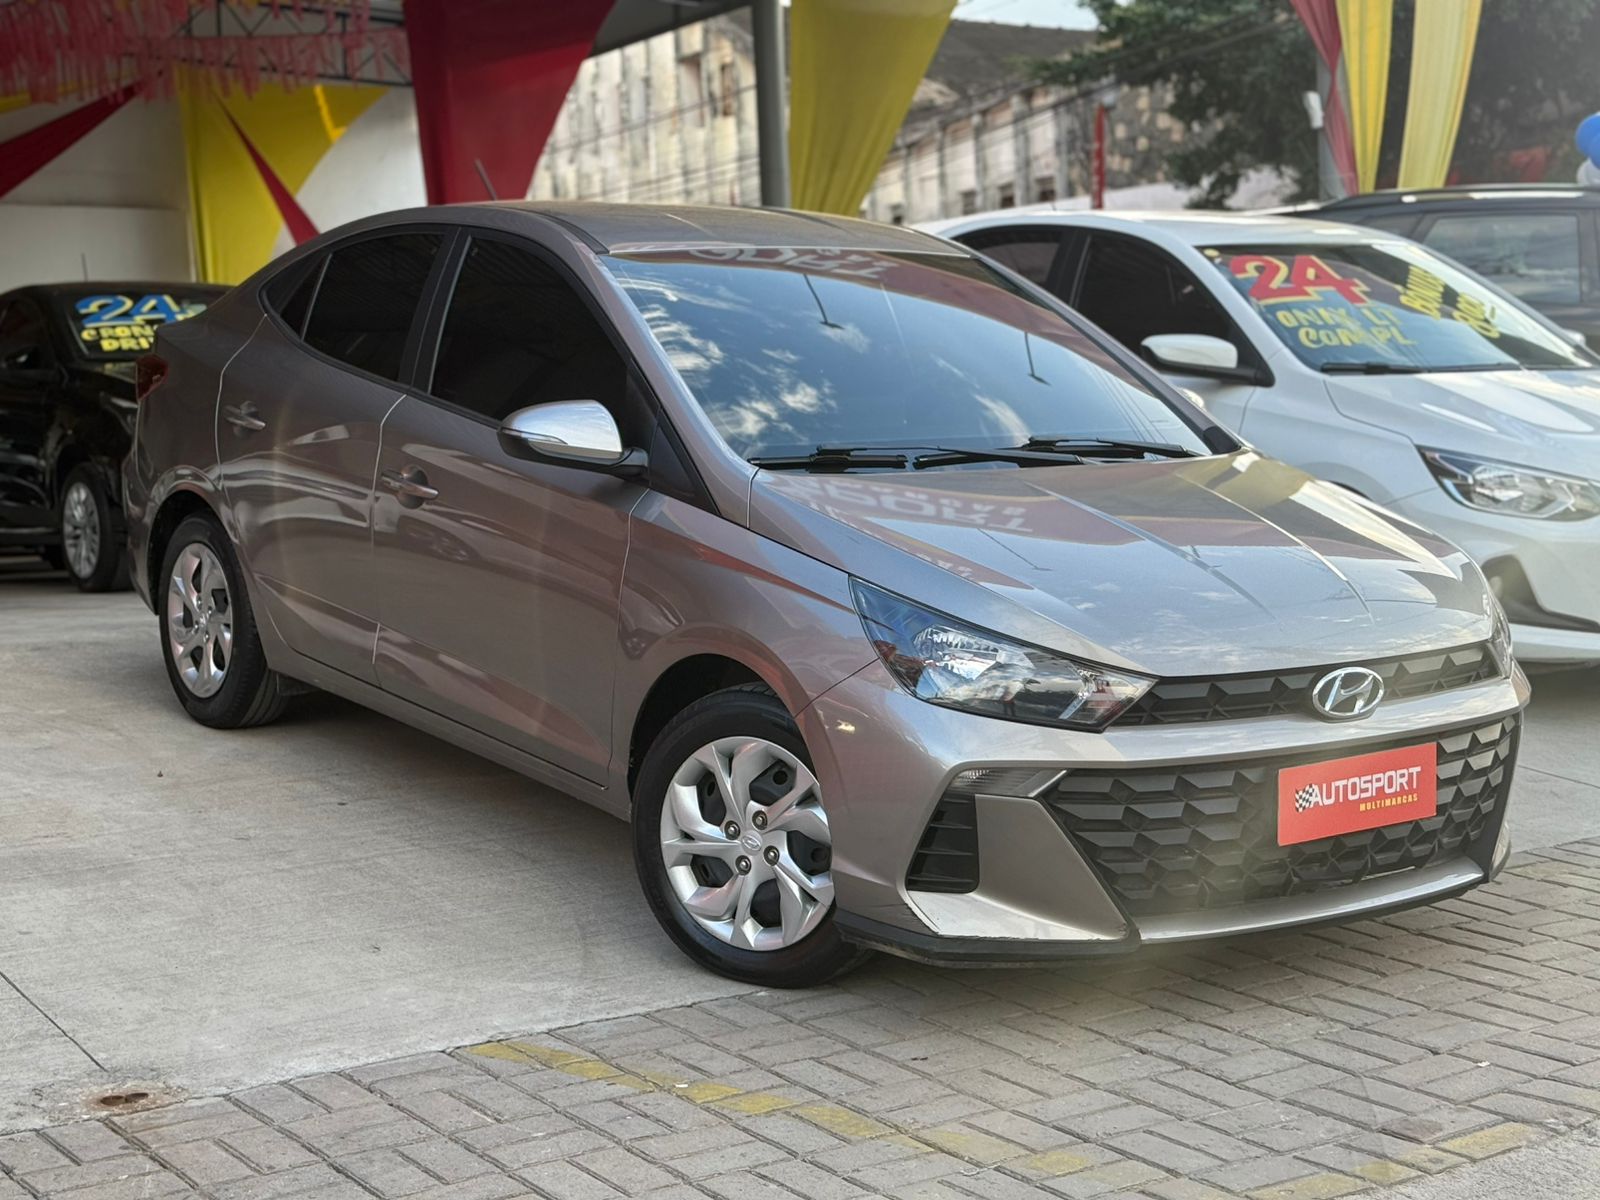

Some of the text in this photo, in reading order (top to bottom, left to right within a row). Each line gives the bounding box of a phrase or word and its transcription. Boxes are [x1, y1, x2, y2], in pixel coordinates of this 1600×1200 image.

[1228, 254, 1371, 305] 24
[75, 294, 193, 328] 24
[80, 325, 158, 341] CRON
[100, 337, 155, 352] DRI
[1309, 766, 1421, 808] AUTOSPORT
[1359, 793, 1418, 812] MULTIMARCAS
